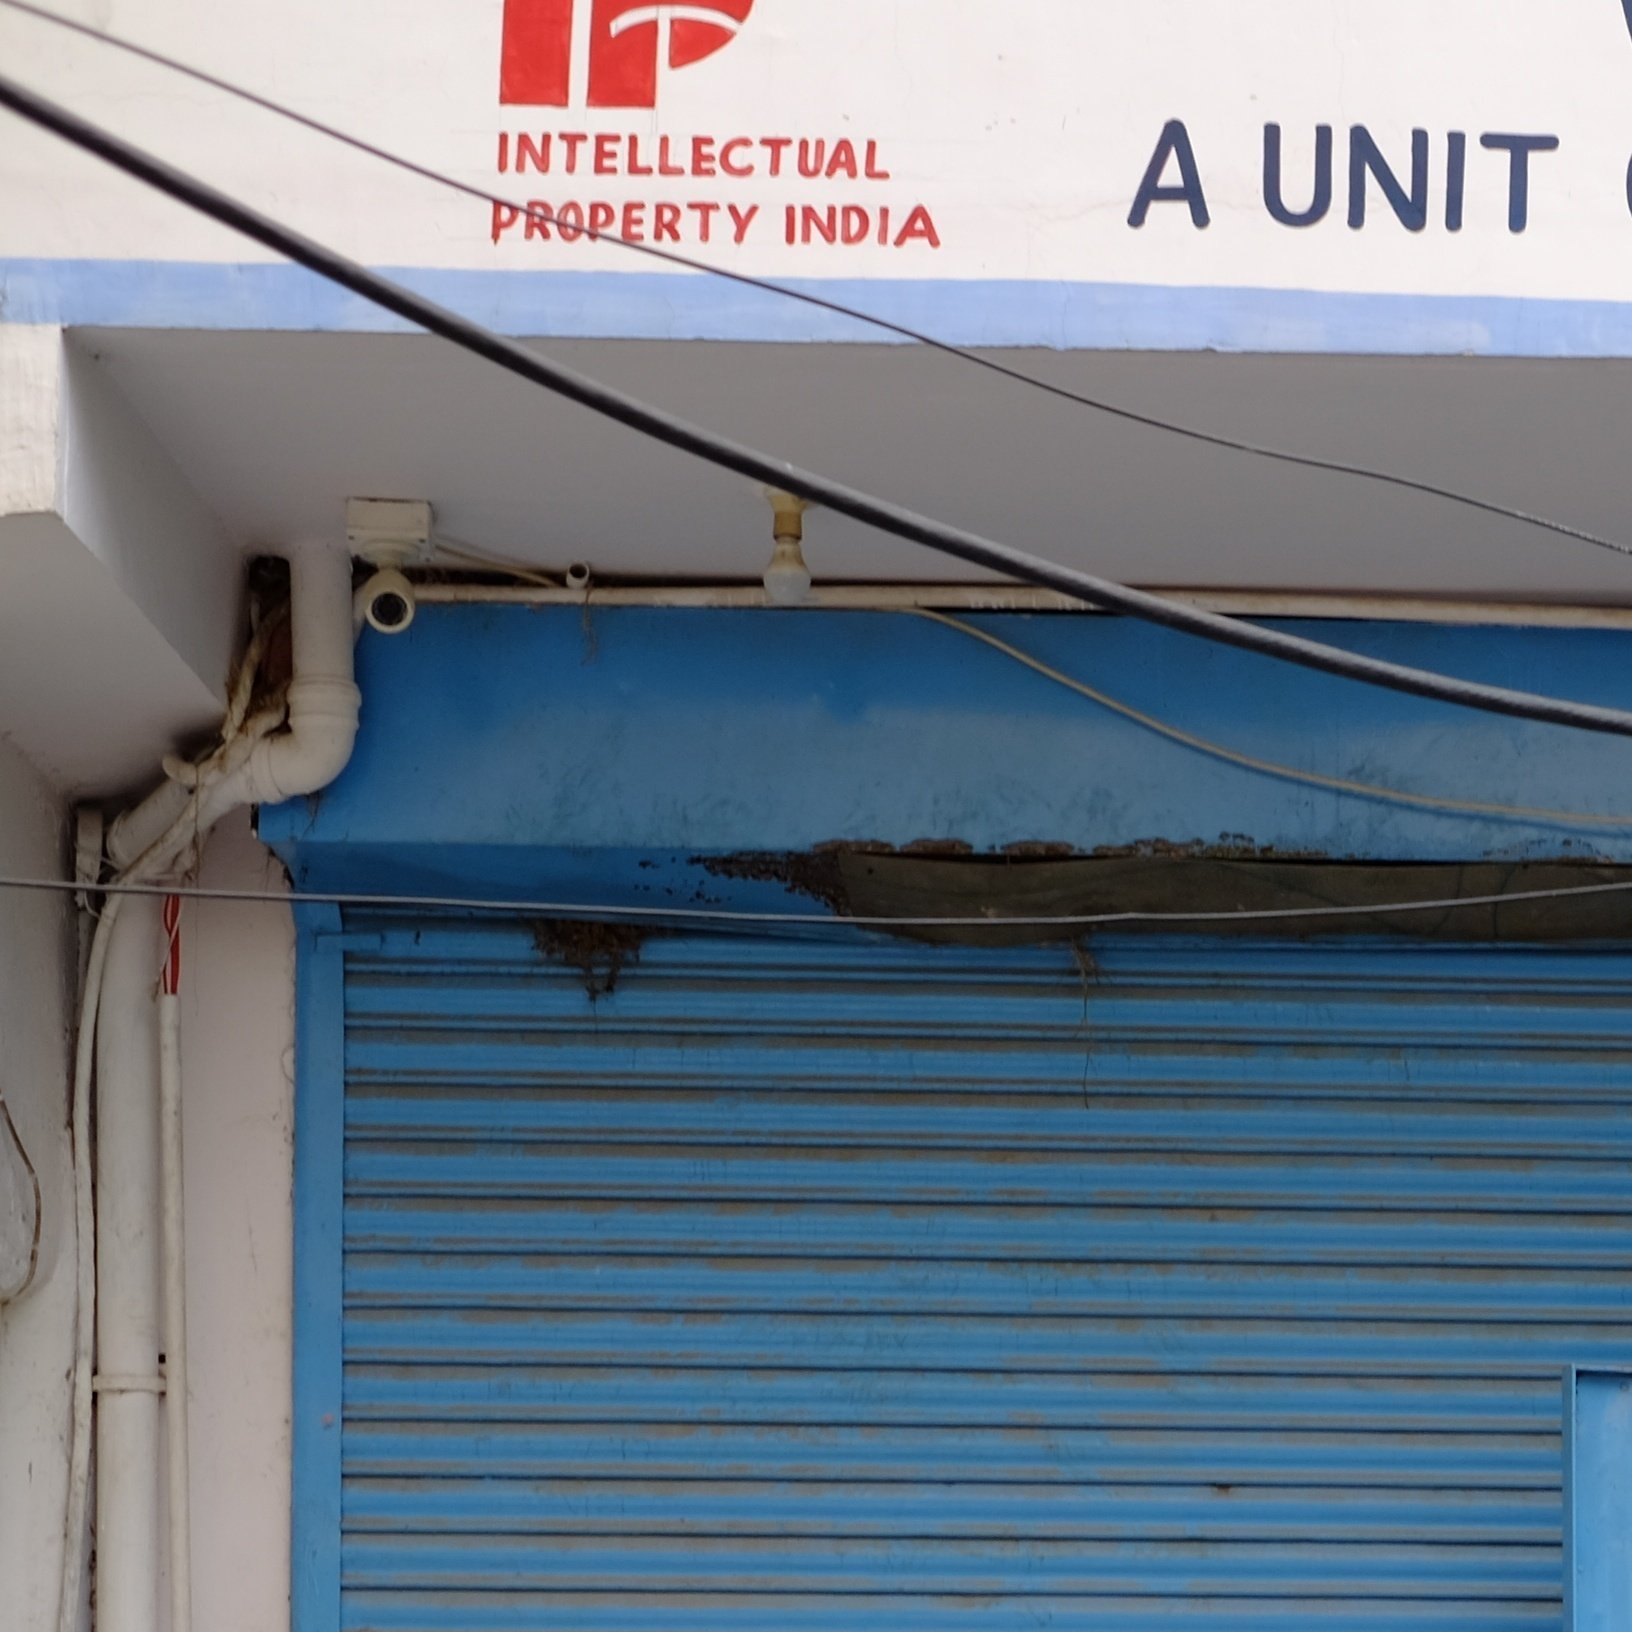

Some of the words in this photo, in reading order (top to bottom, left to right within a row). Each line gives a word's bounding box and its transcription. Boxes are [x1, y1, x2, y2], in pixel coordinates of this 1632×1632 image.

[496, 131, 890, 181] INTELLECTUAL
[1127, 118, 1211, 230] A
[1262, 122, 1560, 236] UNIT
[491, 200, 755, 247] PROPERTY
[784, 203, 940, 249] INDIA
